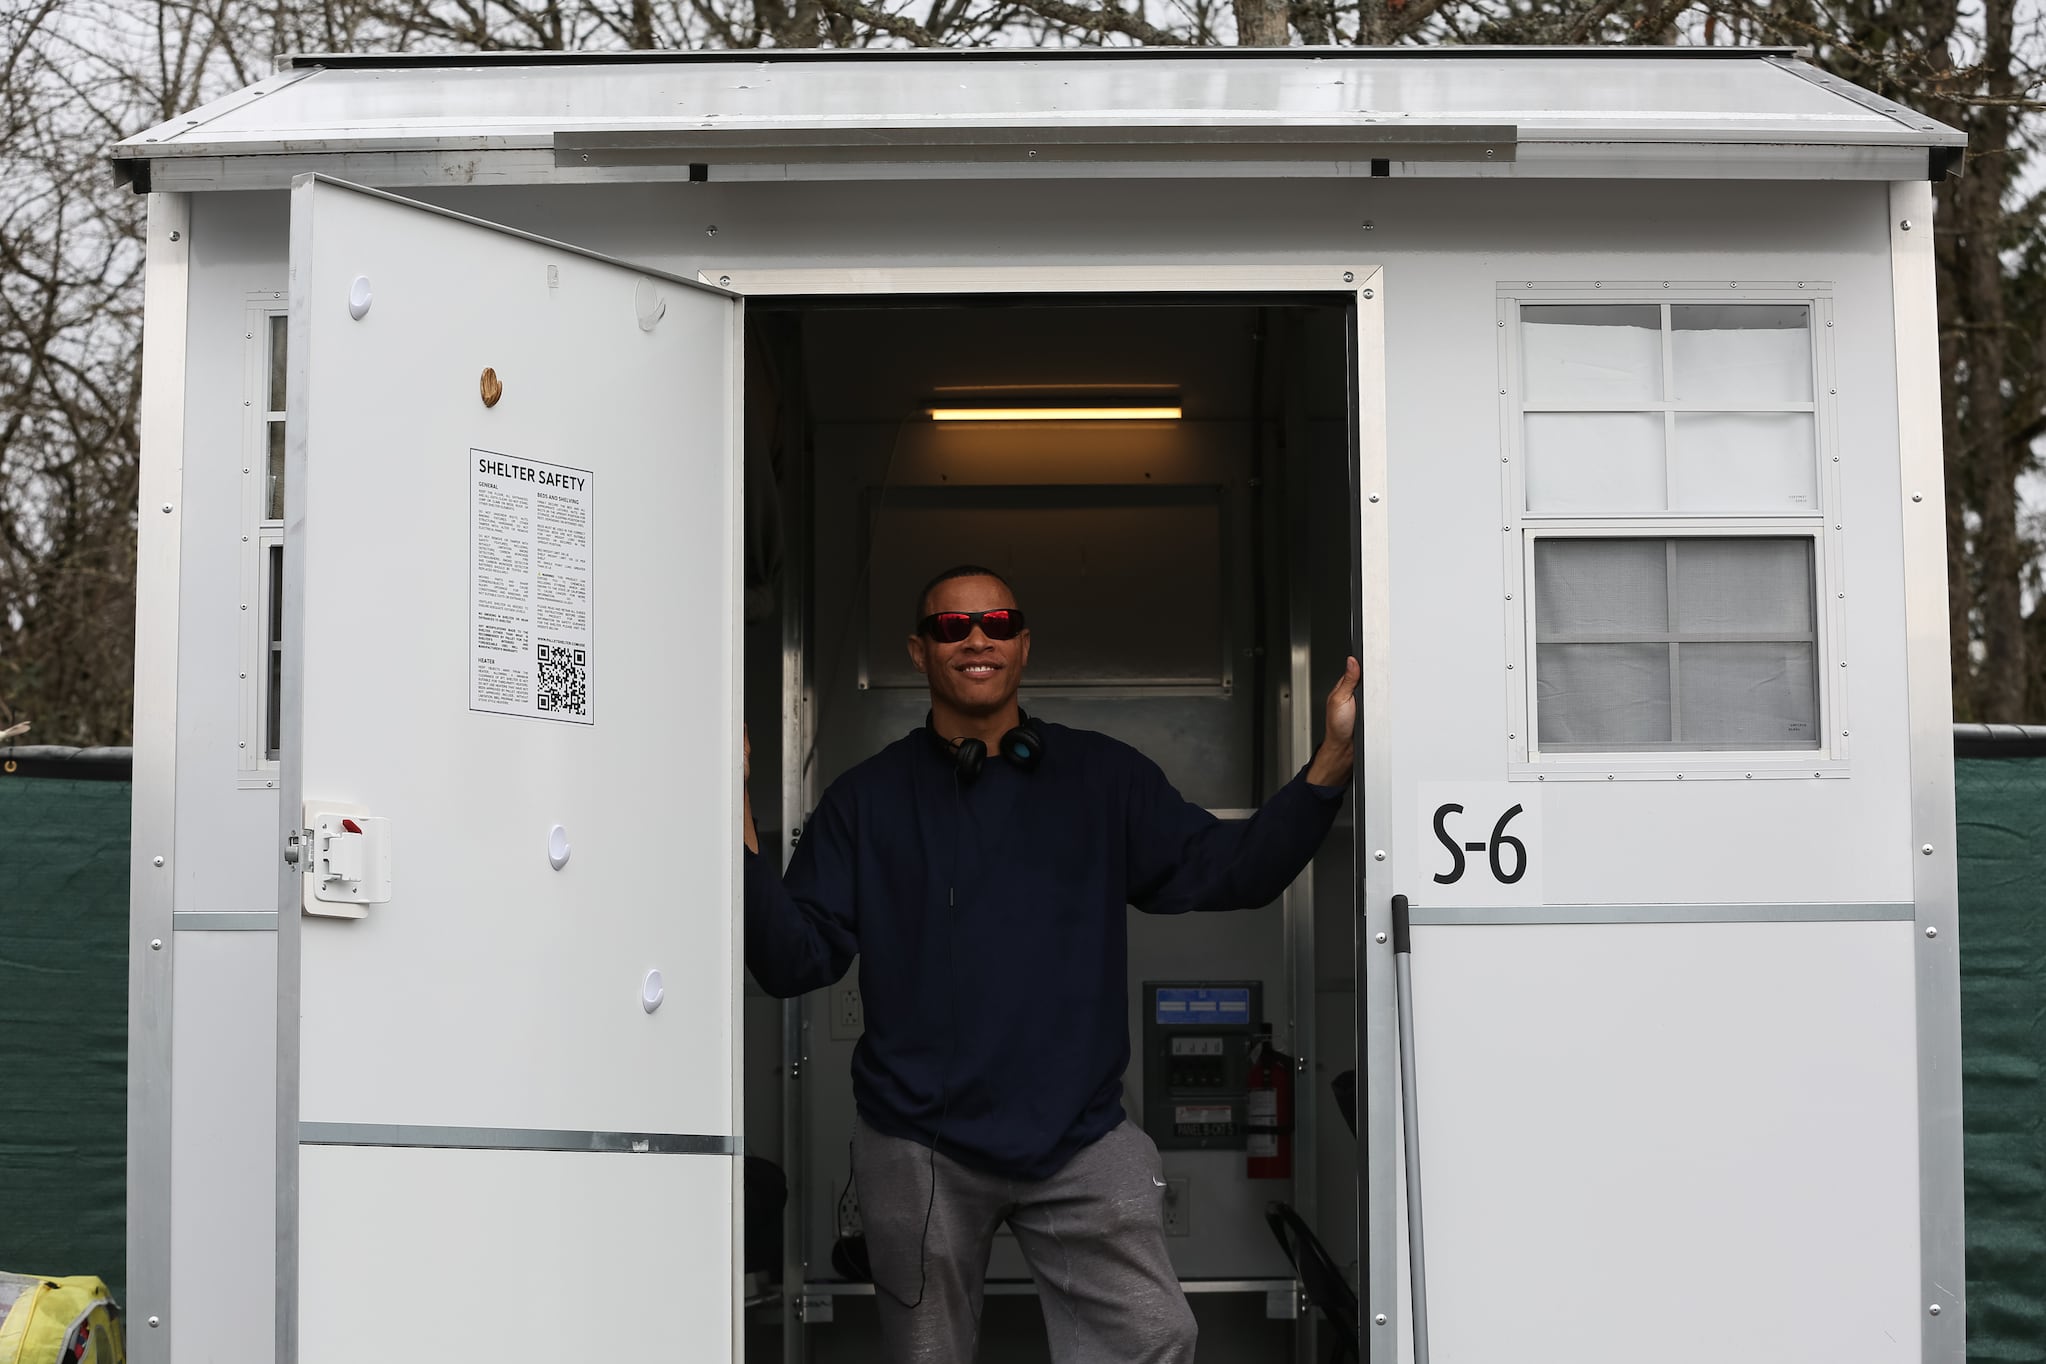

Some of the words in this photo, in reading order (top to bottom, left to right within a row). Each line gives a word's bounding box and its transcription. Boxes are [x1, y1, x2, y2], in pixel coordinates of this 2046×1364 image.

[479, 459, 535, 483] SHELTER
[538, 470, 585, 492] SAFETY
[478, 481, 499, 490] GENERAL
[558, 496, 579, 505] SHELVING
[478, 657, 495, 665] HEATER
[1433, 803, 1527, 884] S-6
[1177, 1123, 1201, 1136] PANEL
